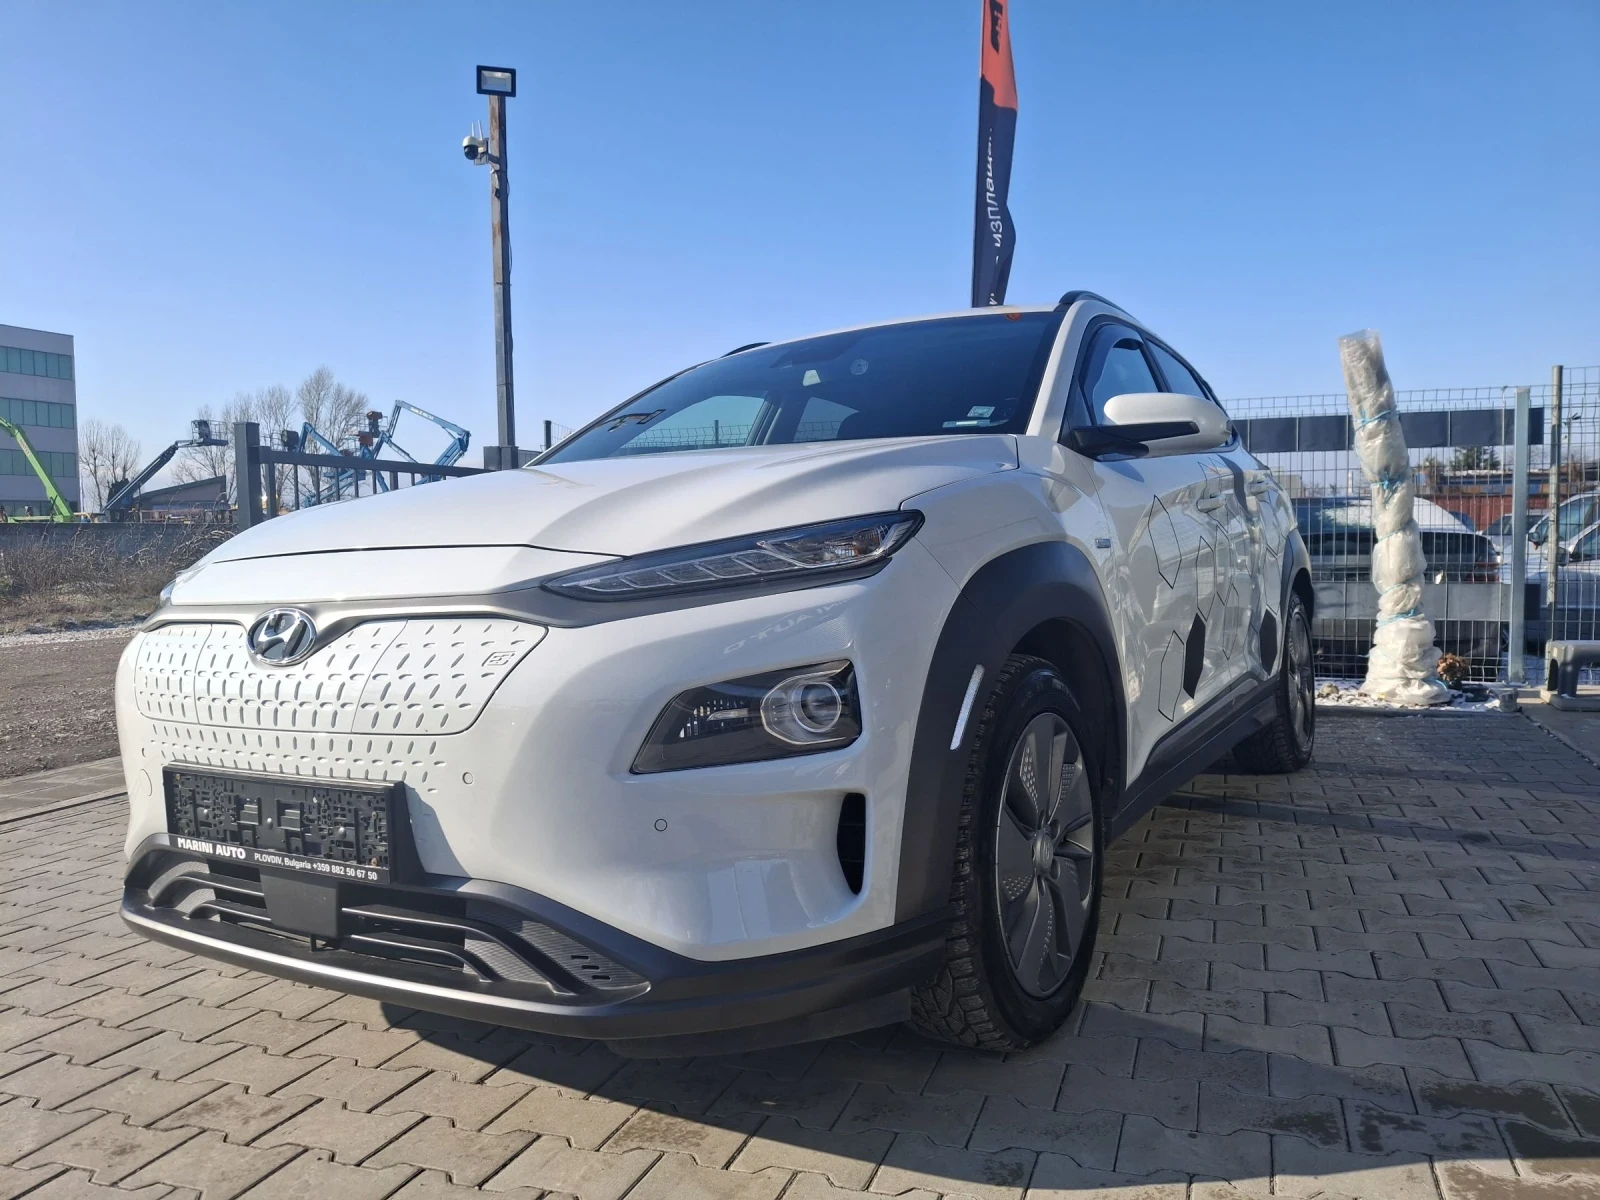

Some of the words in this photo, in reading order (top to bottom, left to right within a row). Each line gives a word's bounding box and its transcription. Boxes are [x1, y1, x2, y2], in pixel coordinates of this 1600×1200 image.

[177, 837, 213, 854] MARINI
[215, 844, 246, 860] AUTO
[254, 852, 283, 866] PLOVDIV,
[284, 857, 312, 869] Bulgaria
[312, 862, 330, 872] +359
[331, 864, 345, 875] 882
[346, 868, 355, 877] 50
[356, 870, 366, 879] 67
[367, 871, 378, 881] 50
